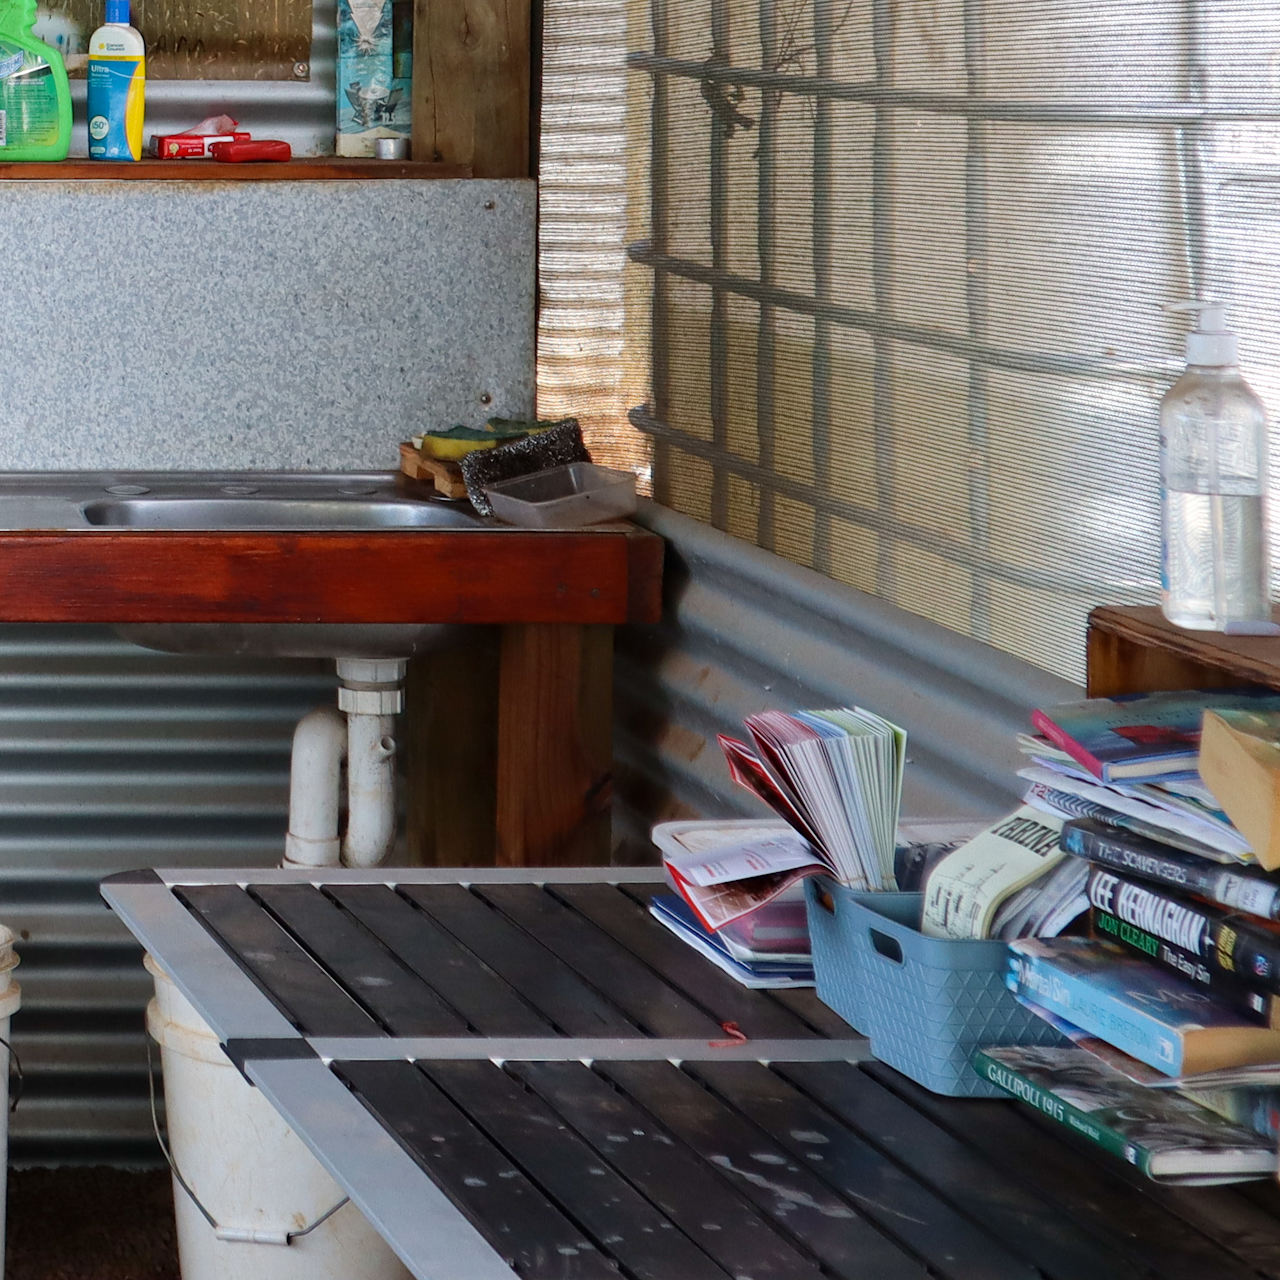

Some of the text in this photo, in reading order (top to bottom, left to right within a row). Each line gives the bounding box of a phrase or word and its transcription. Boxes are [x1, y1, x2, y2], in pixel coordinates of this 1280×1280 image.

[1098, 842, 1188, 884] THE SCAVENGERS
[1091, 870, 1120, 915] LEE
[1118, 882, 1206, 956] KERNAGHAN
[1098, 912, 1160, 958] JON CLEARY
[1161, 944, 1211, 985] The Easy Sin
[987, 1064, 1065, 1122] GALLIPOLI 1915
